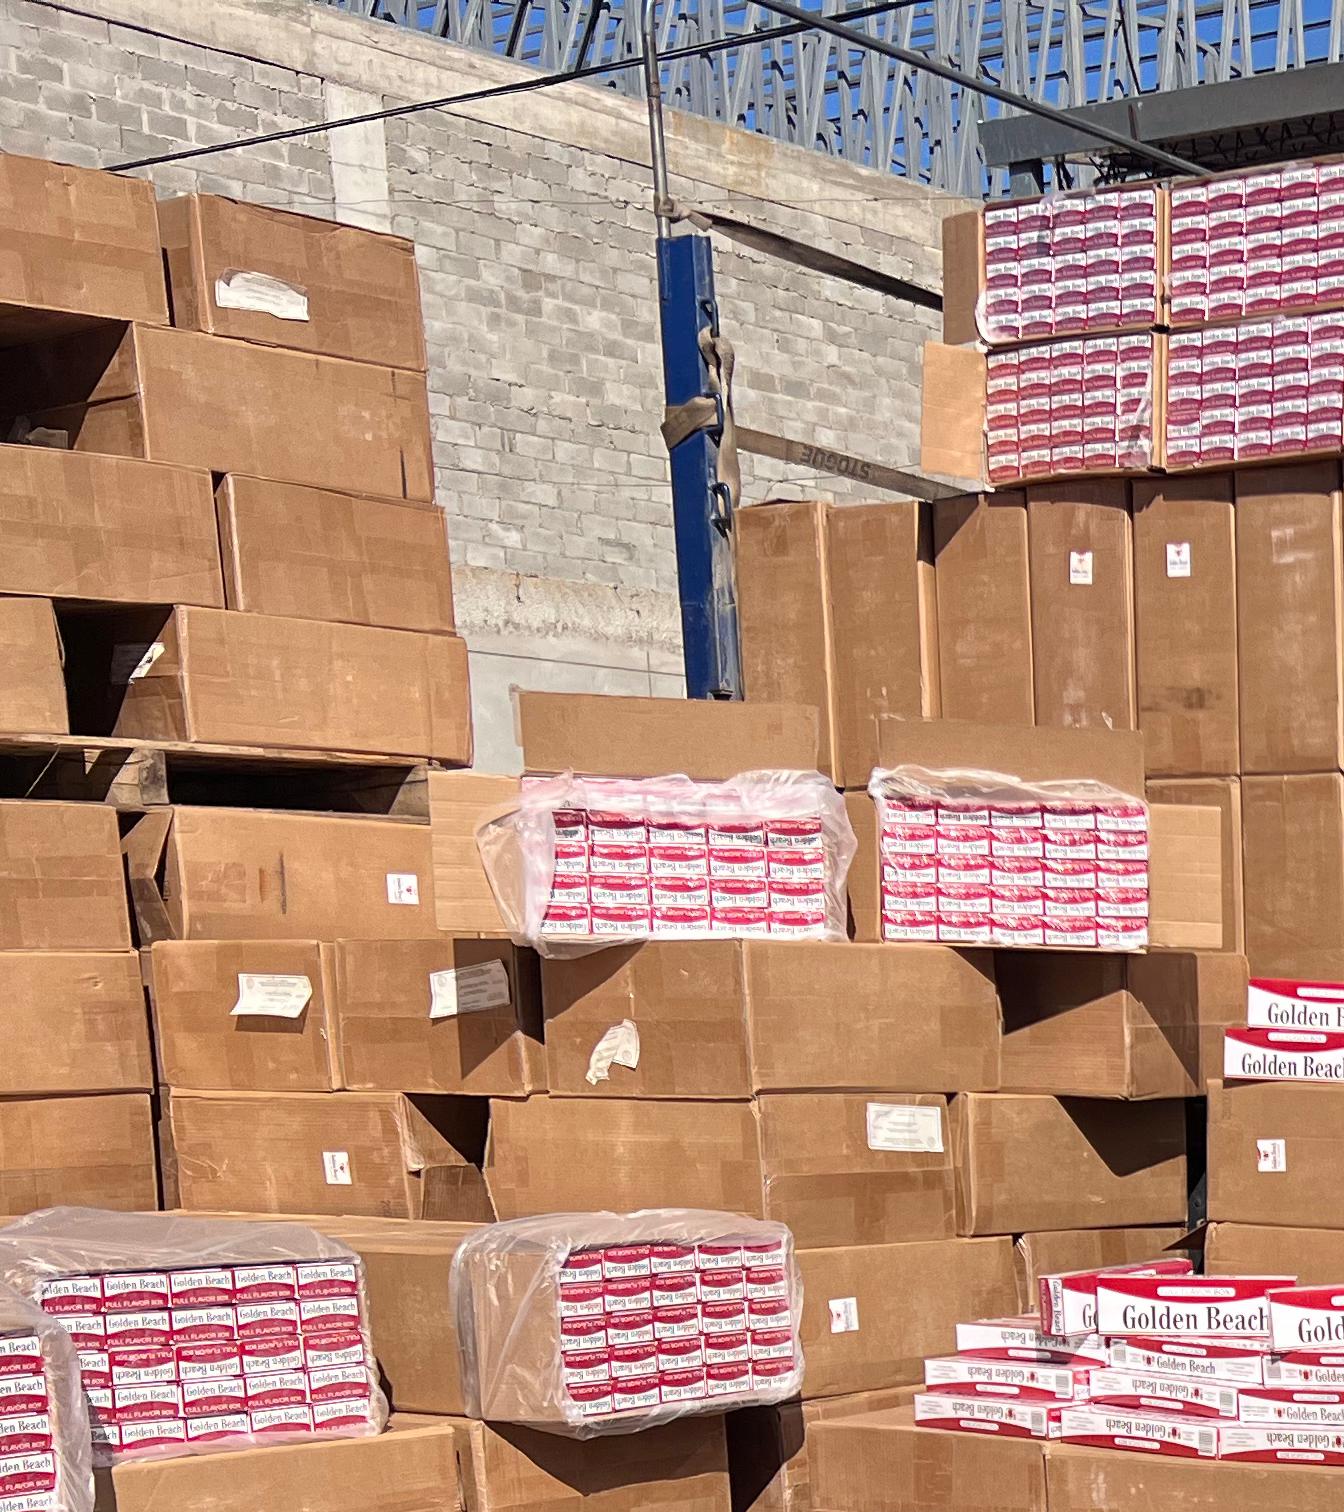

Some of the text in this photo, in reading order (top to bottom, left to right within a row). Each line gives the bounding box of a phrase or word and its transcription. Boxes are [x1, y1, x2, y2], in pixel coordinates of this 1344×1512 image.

[1268, 1003, 1329, 1027] Golden
[1242, 1053, 1297, 1076] Golden
[106, 1279, 164, 1290] Golden Beach
[1123, 1306, 1269, 1331] Golden Beach
[1157, 1357, 1215, 1374] Golden Beach
[1287, 1407, 1319, 1421] Golden
